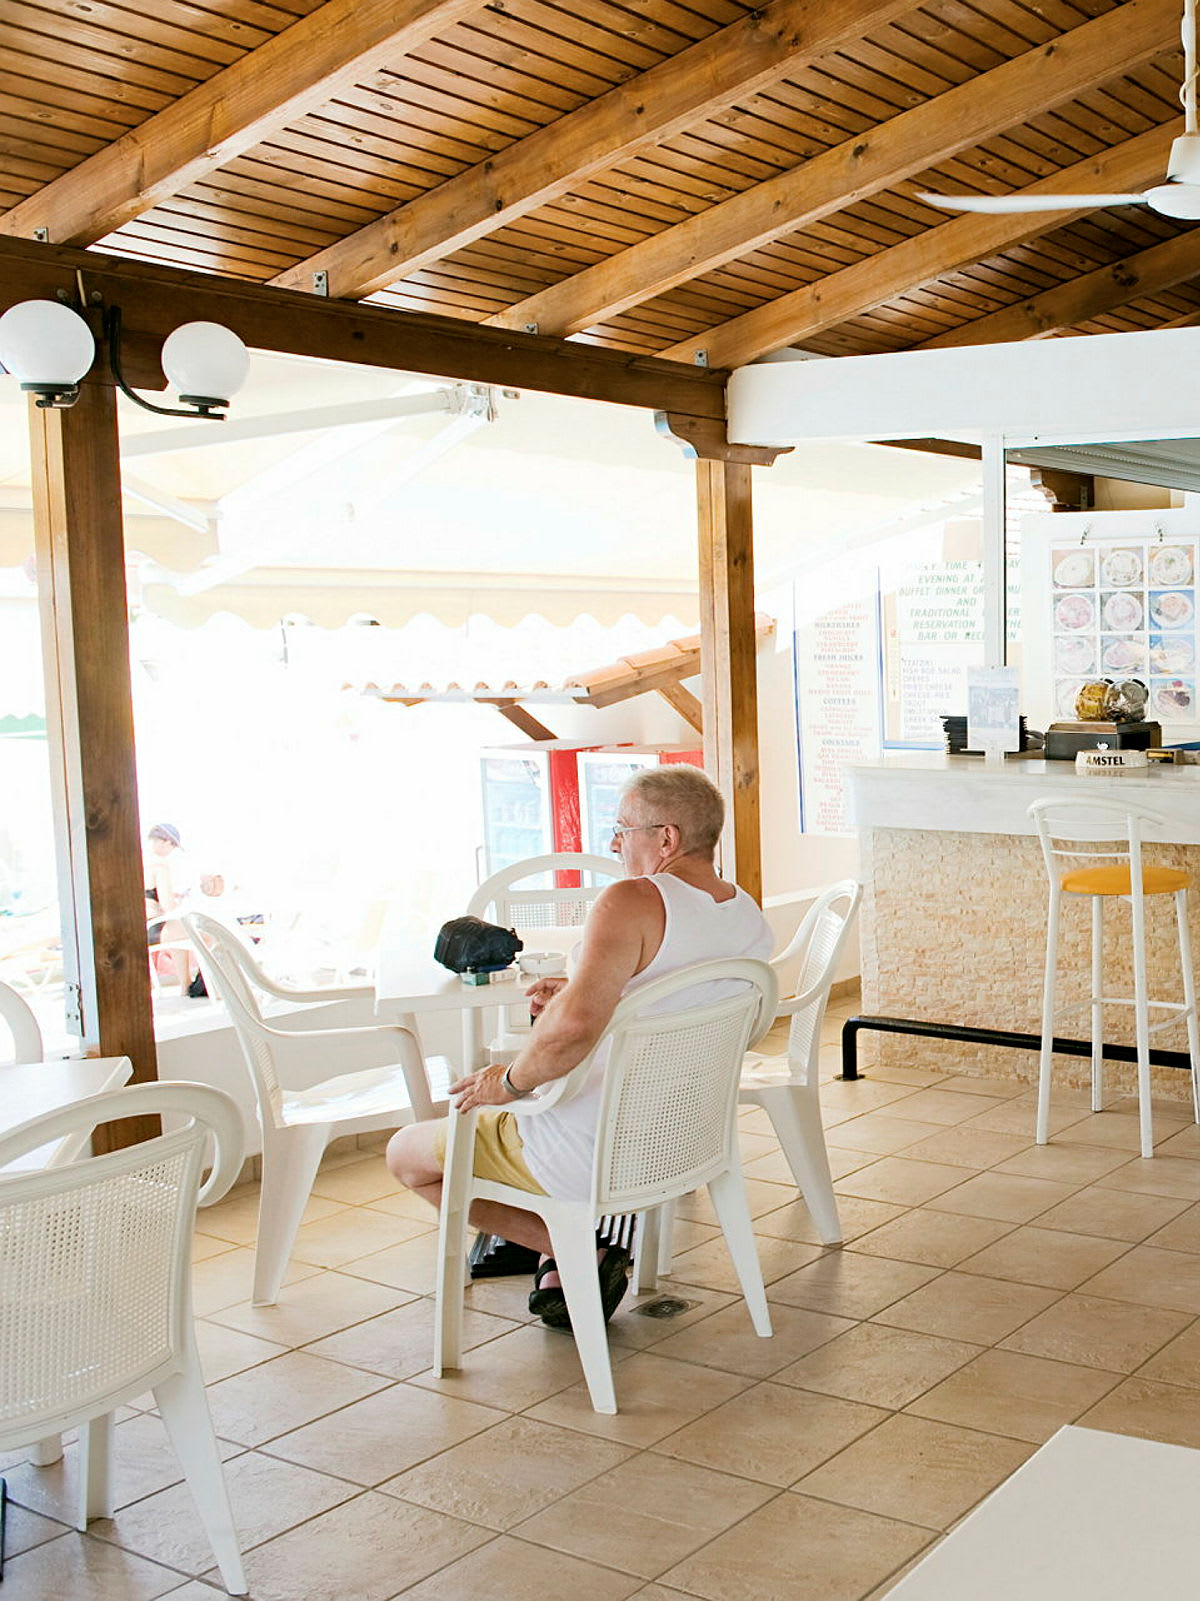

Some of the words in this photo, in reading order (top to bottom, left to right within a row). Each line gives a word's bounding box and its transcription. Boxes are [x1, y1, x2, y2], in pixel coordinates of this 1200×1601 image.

[945, 560, 967, 570] TIME
[918, 574, 958, 584] EVENING
[899, 587, 929, 597] BUFFET
[936, 586, 967, 596] DINNER
[956, 598, 976, 607] AND
[910, 608, 969, 618] TRADITIONAL
[913, 620, 976, 630] RESERVATION
[918, 631, 937, 641] BAR
[944, 631, 958, 641] OR
[1086, 756, 1125, 766] AMSTEL
